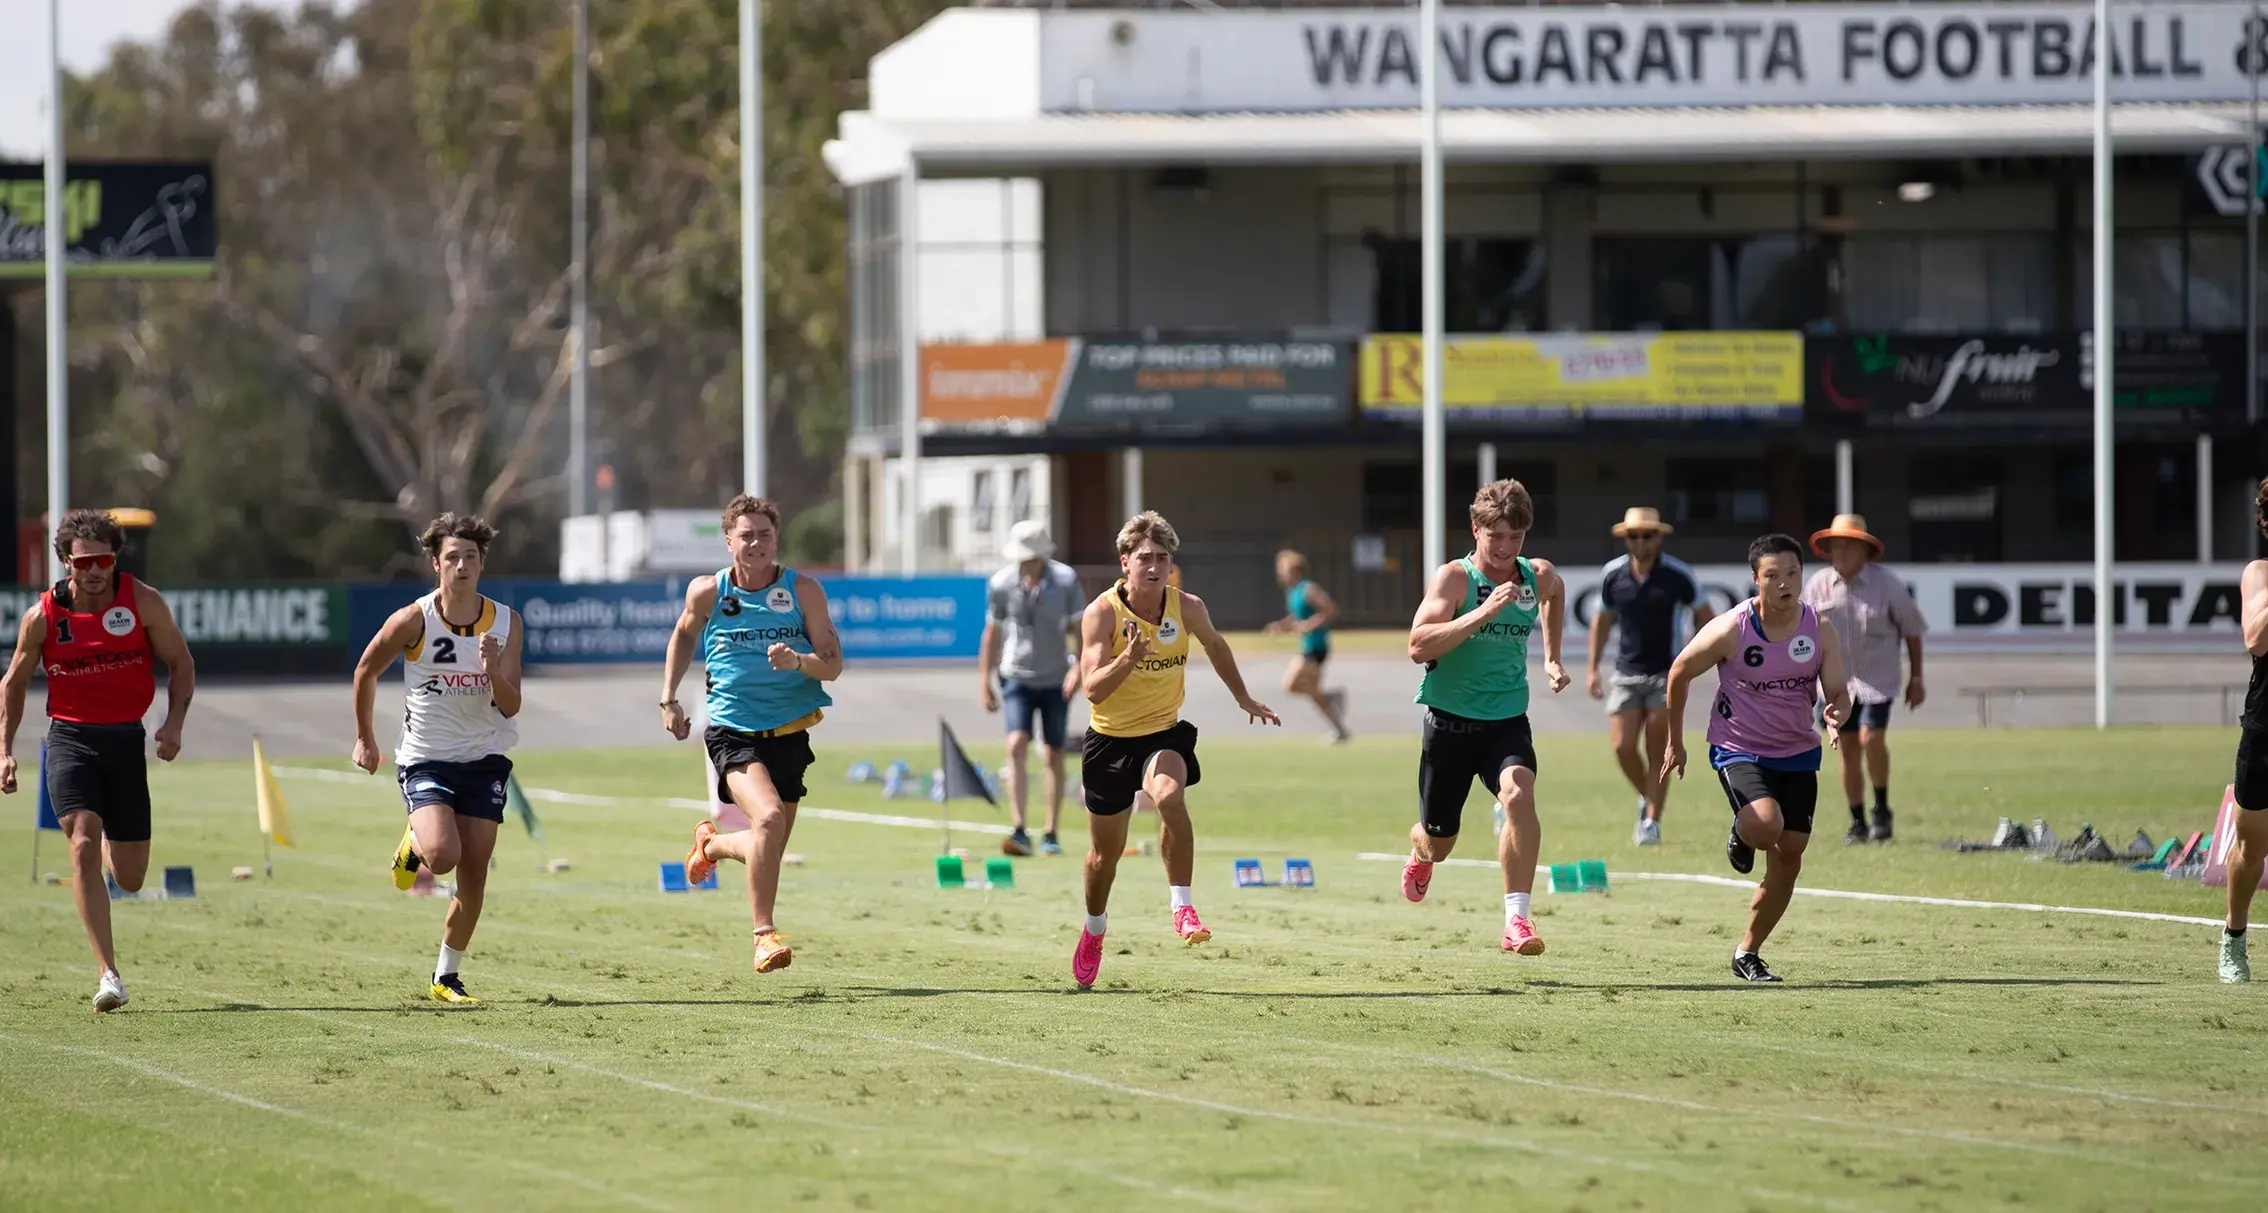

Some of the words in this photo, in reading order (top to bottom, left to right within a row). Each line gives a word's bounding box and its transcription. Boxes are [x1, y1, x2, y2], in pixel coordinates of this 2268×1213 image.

[1305, 22, 1805, 85] WANGARATTA
[1841, 17, 2203, 81] FOOTBALL
[722, 595, 741, 616] 3
[56, 617, 74, 643] 1
[432, 637, 457, 664] 2
[1134, 653, 1187, 671] CTORIAN
[1743, 645, 1764, 667] 6
